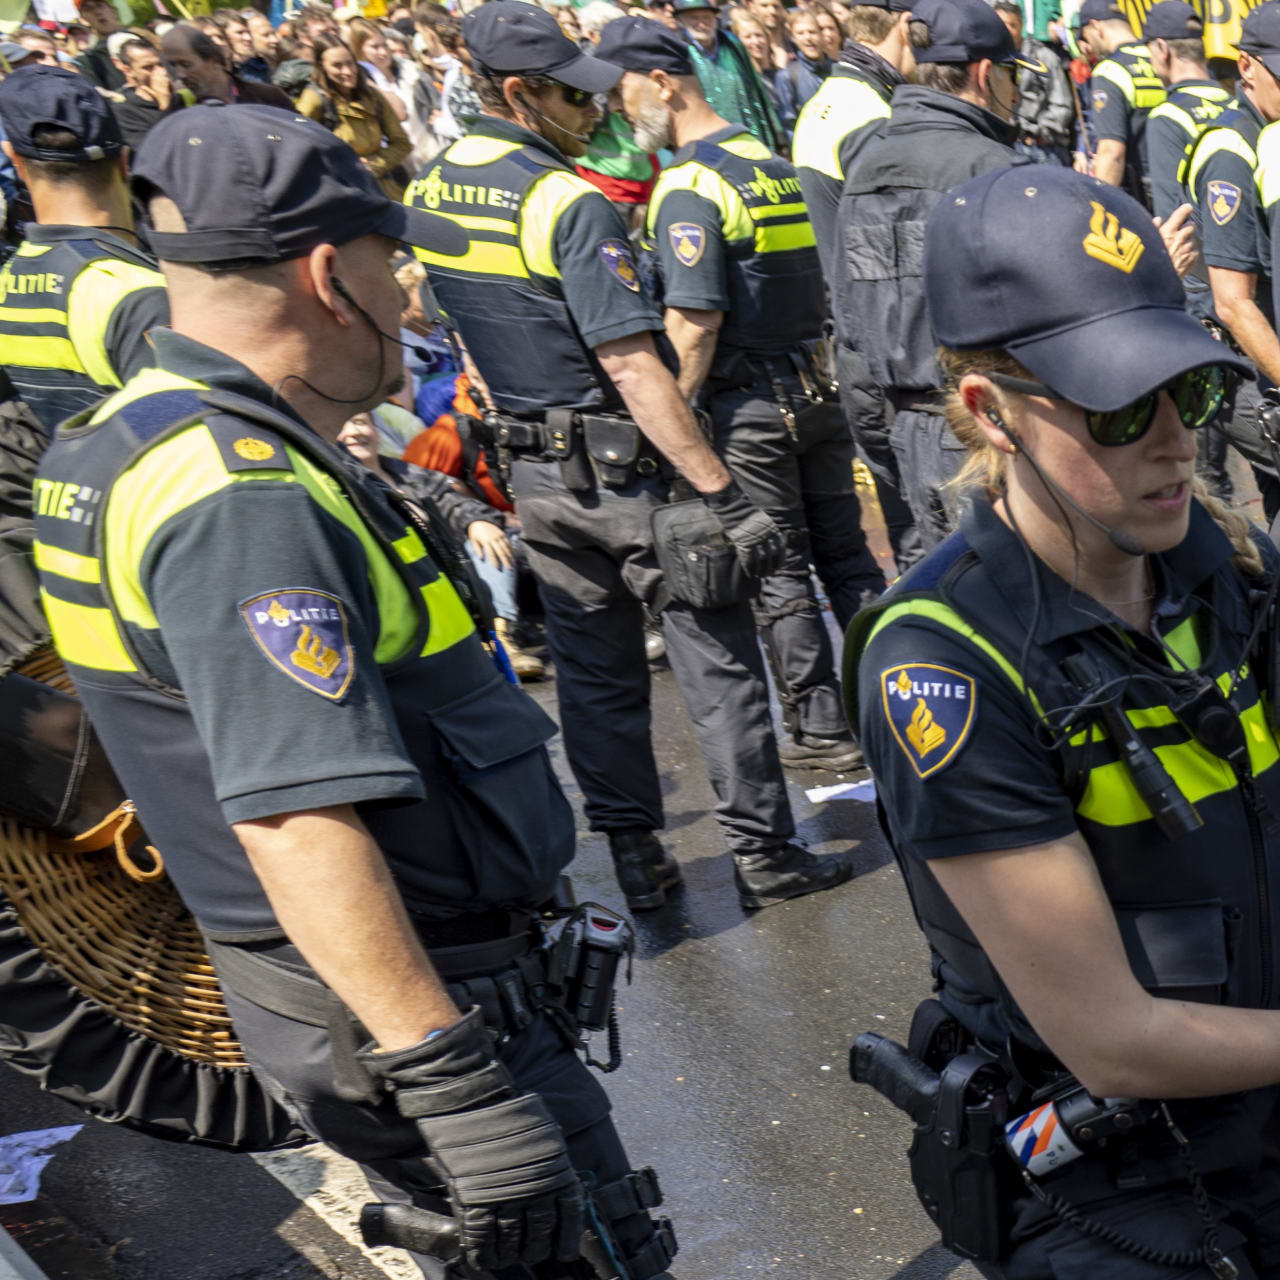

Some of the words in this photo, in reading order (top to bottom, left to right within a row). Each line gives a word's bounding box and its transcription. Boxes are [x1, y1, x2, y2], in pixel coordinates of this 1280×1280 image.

[403, 165, 503, 209] POLITIE
[254, 600, 341, 627] POLITIE
[888, 670, 967, 701] POLITIE
